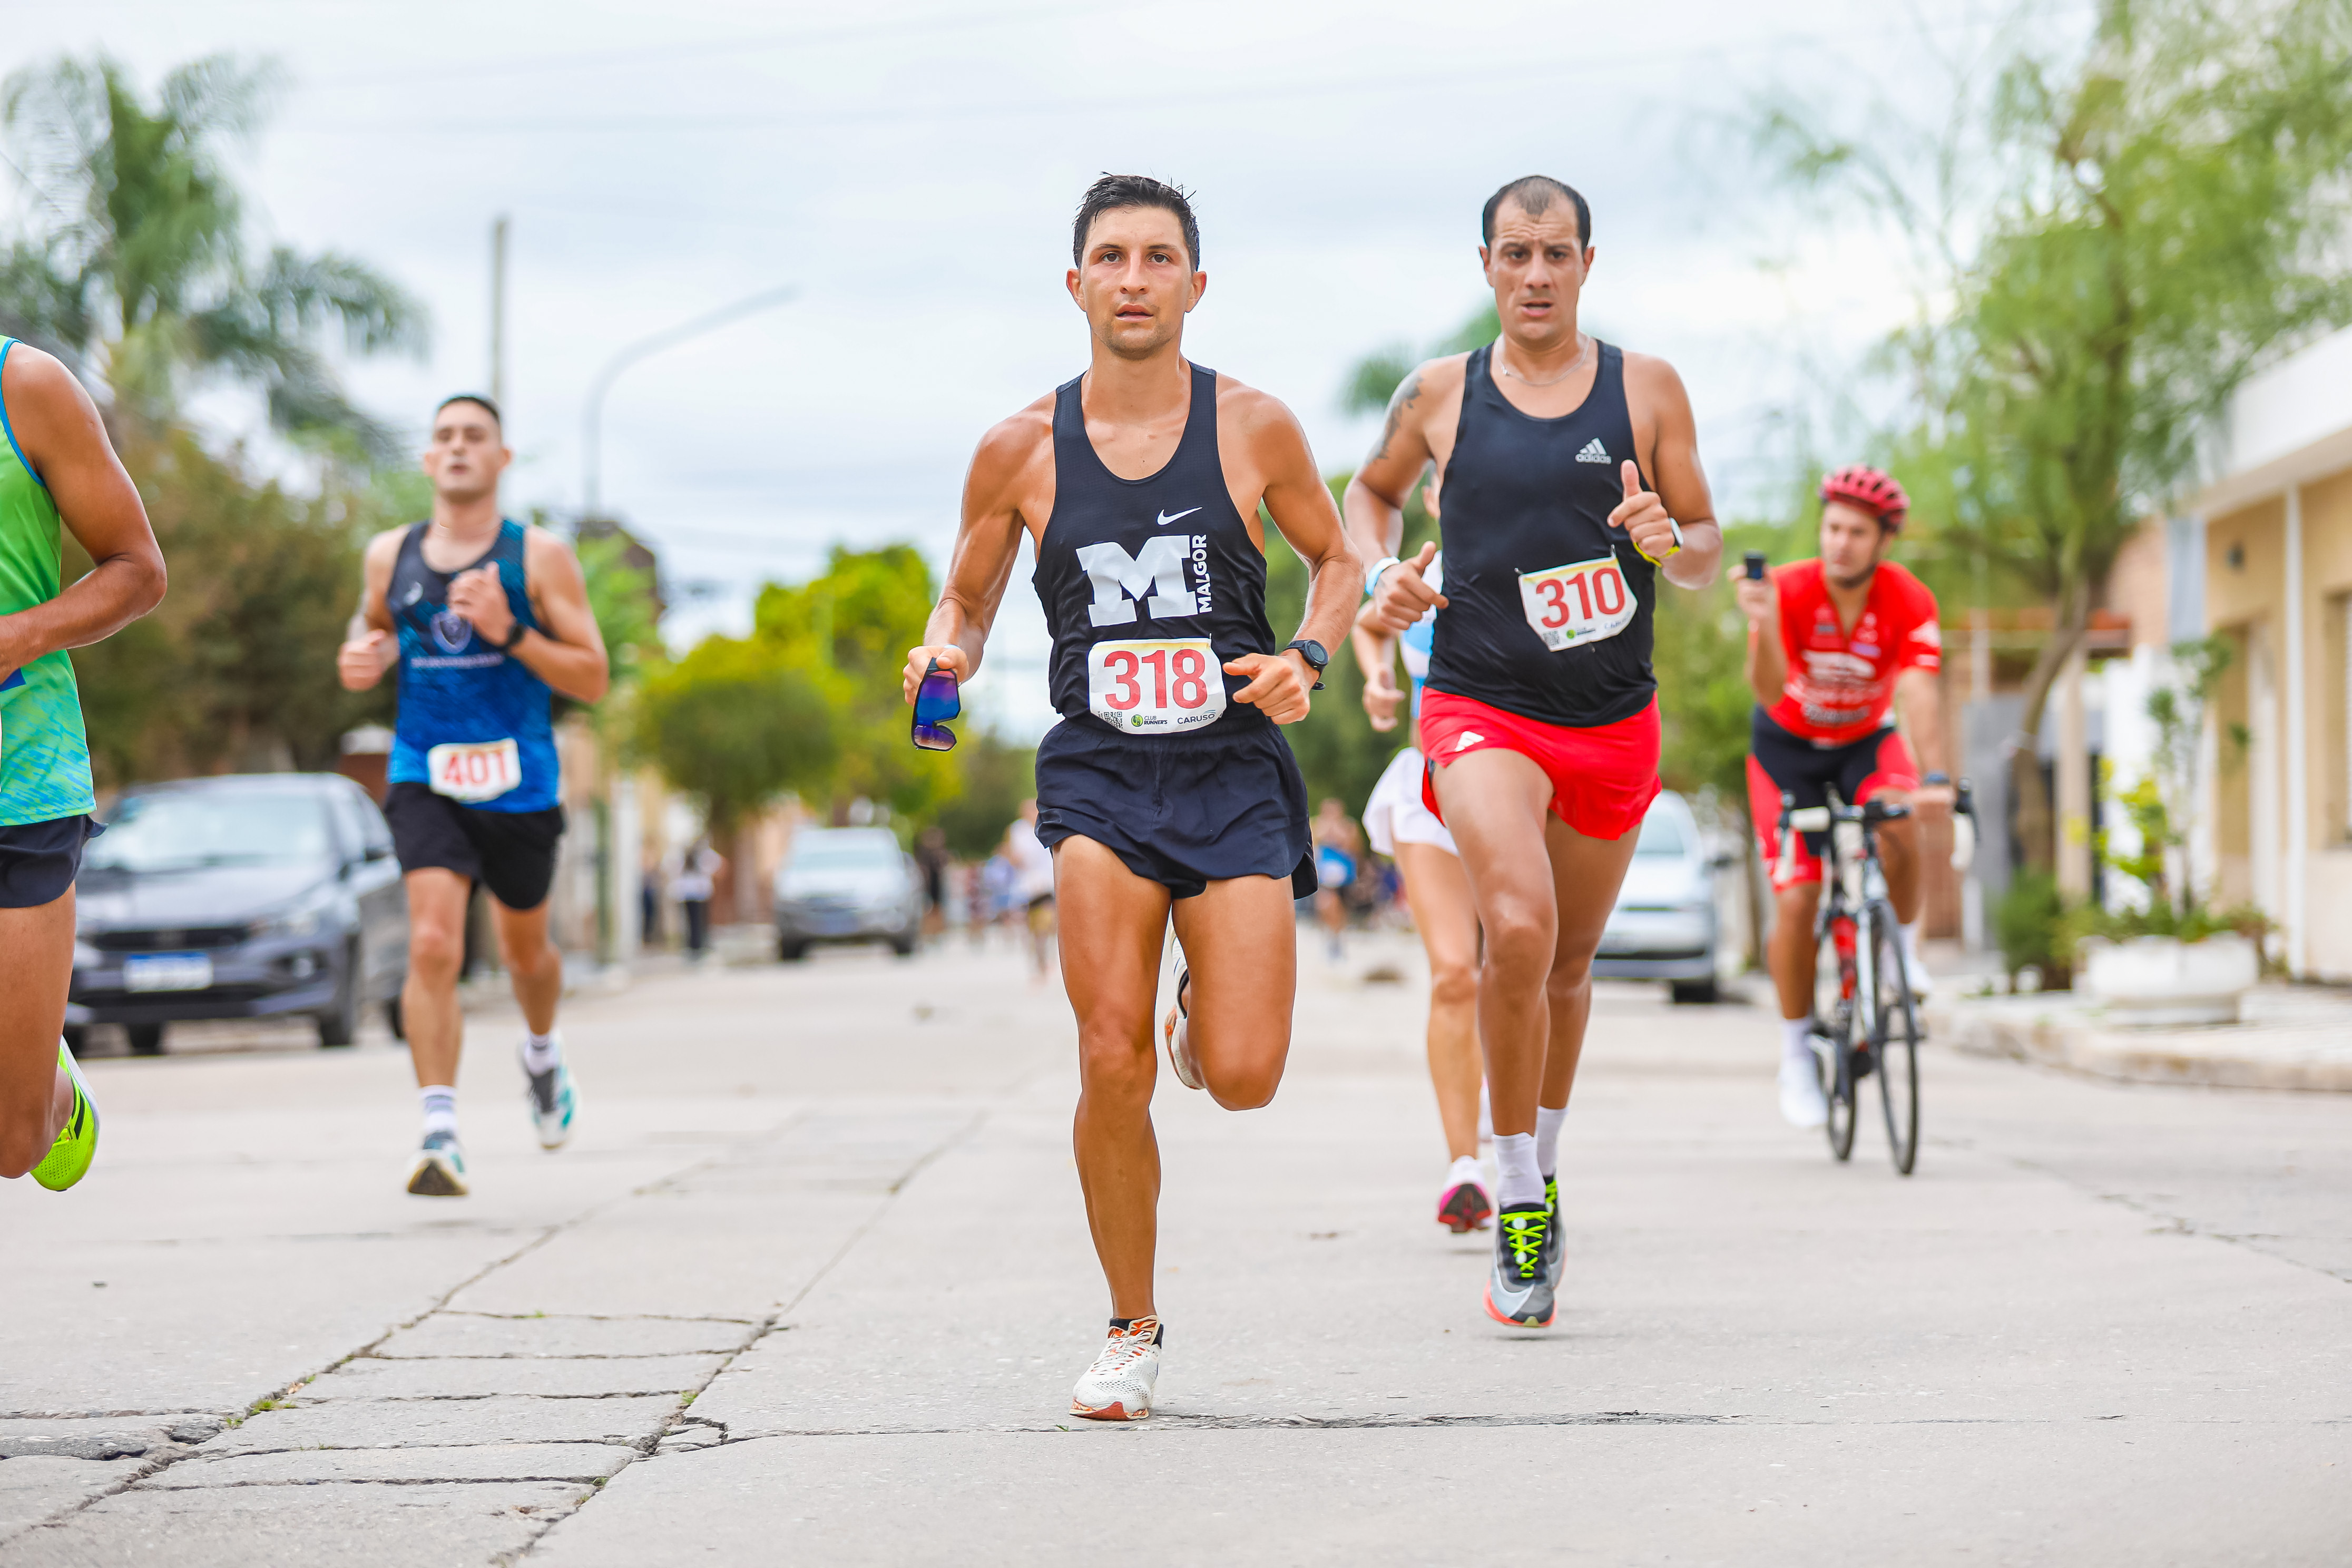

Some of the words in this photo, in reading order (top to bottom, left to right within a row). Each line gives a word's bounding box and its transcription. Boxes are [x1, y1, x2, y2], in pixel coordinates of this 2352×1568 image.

[1076, 535, 1198, 627] M
[1192, 534, 1212, 613] MALGOR
[1535, 567, 1625, 628] 310
[1104, 649, 1209, 710] 318
[1177, 713, 1215, 724] CARUSO
[444, 748, 509, 785] 401
